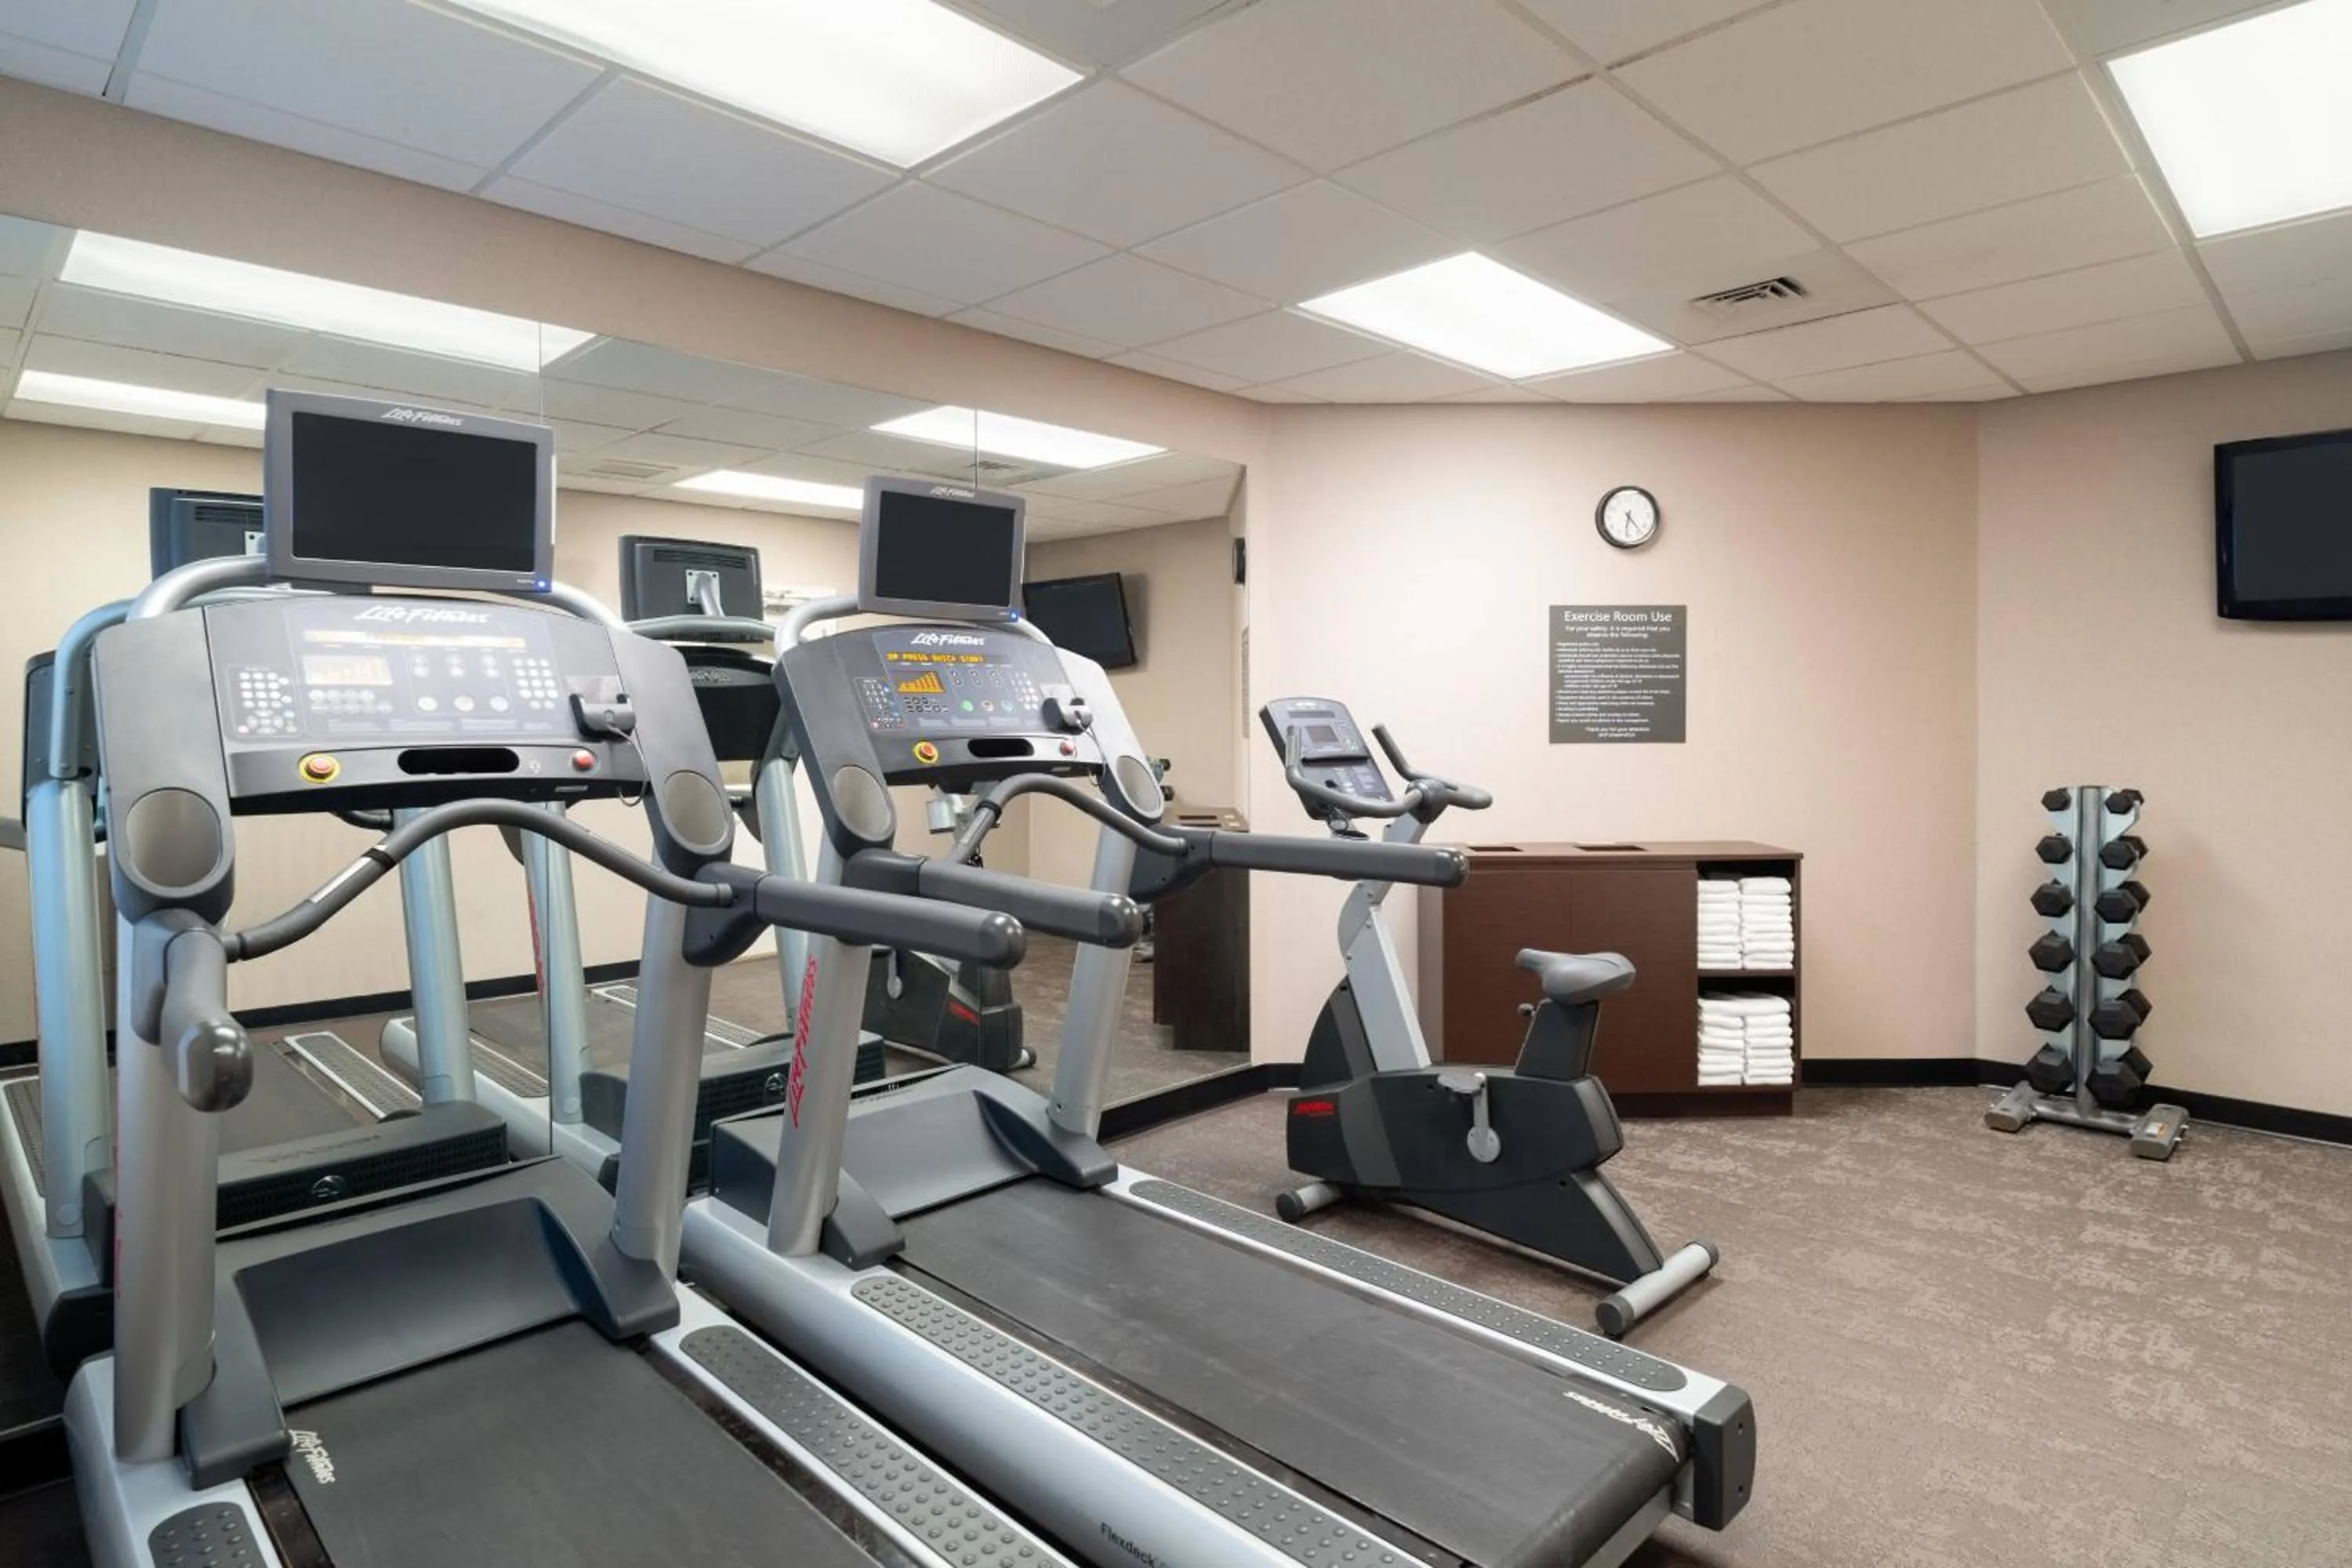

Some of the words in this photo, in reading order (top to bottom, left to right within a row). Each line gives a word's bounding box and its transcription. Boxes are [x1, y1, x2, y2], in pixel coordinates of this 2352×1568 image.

[1564, 611, 1610, 622] Exercise
[1613, 611, 1647, 622] Room
[1650, 611, 1672, 622] Use
[1101, 1522, 1156, 1568] Flexdeck
